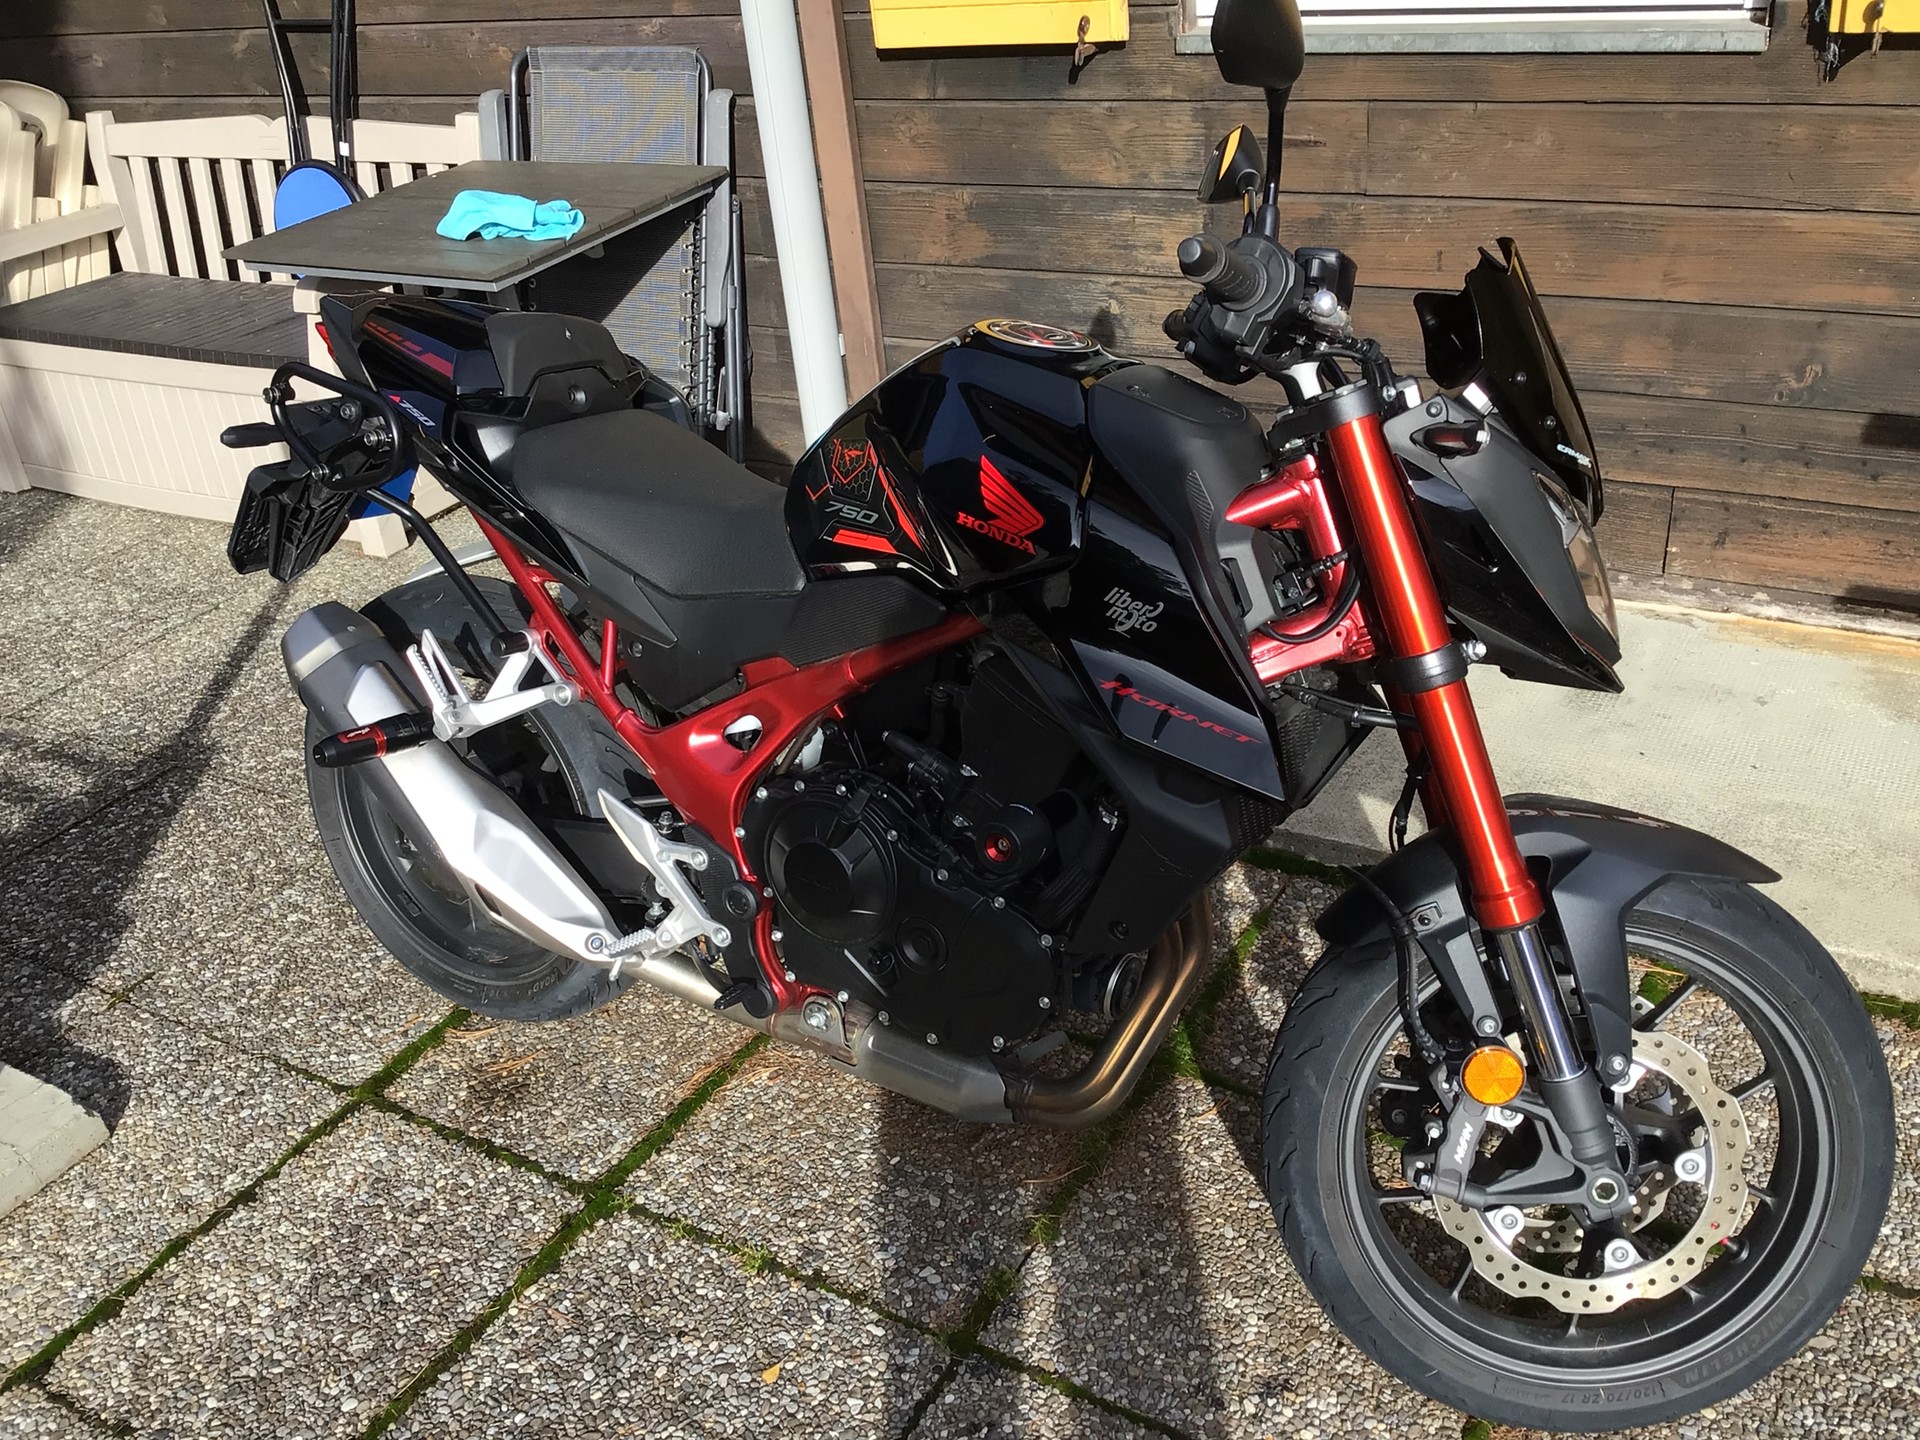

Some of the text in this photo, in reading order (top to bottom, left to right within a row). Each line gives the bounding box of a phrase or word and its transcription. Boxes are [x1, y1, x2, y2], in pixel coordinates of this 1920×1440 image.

[399, 400, 436, 427] 750
[825, 500, 879, 525] 750
[956, 511, 1037, 556] HONDA
[1098, 678, 1263, 744] HORNET
[1684, 1313, 1785, 1387] MICHELIN
[1581, 1391, 1602, 1405] ZR
[1606, 1383, 1657, 1404] 120/70
